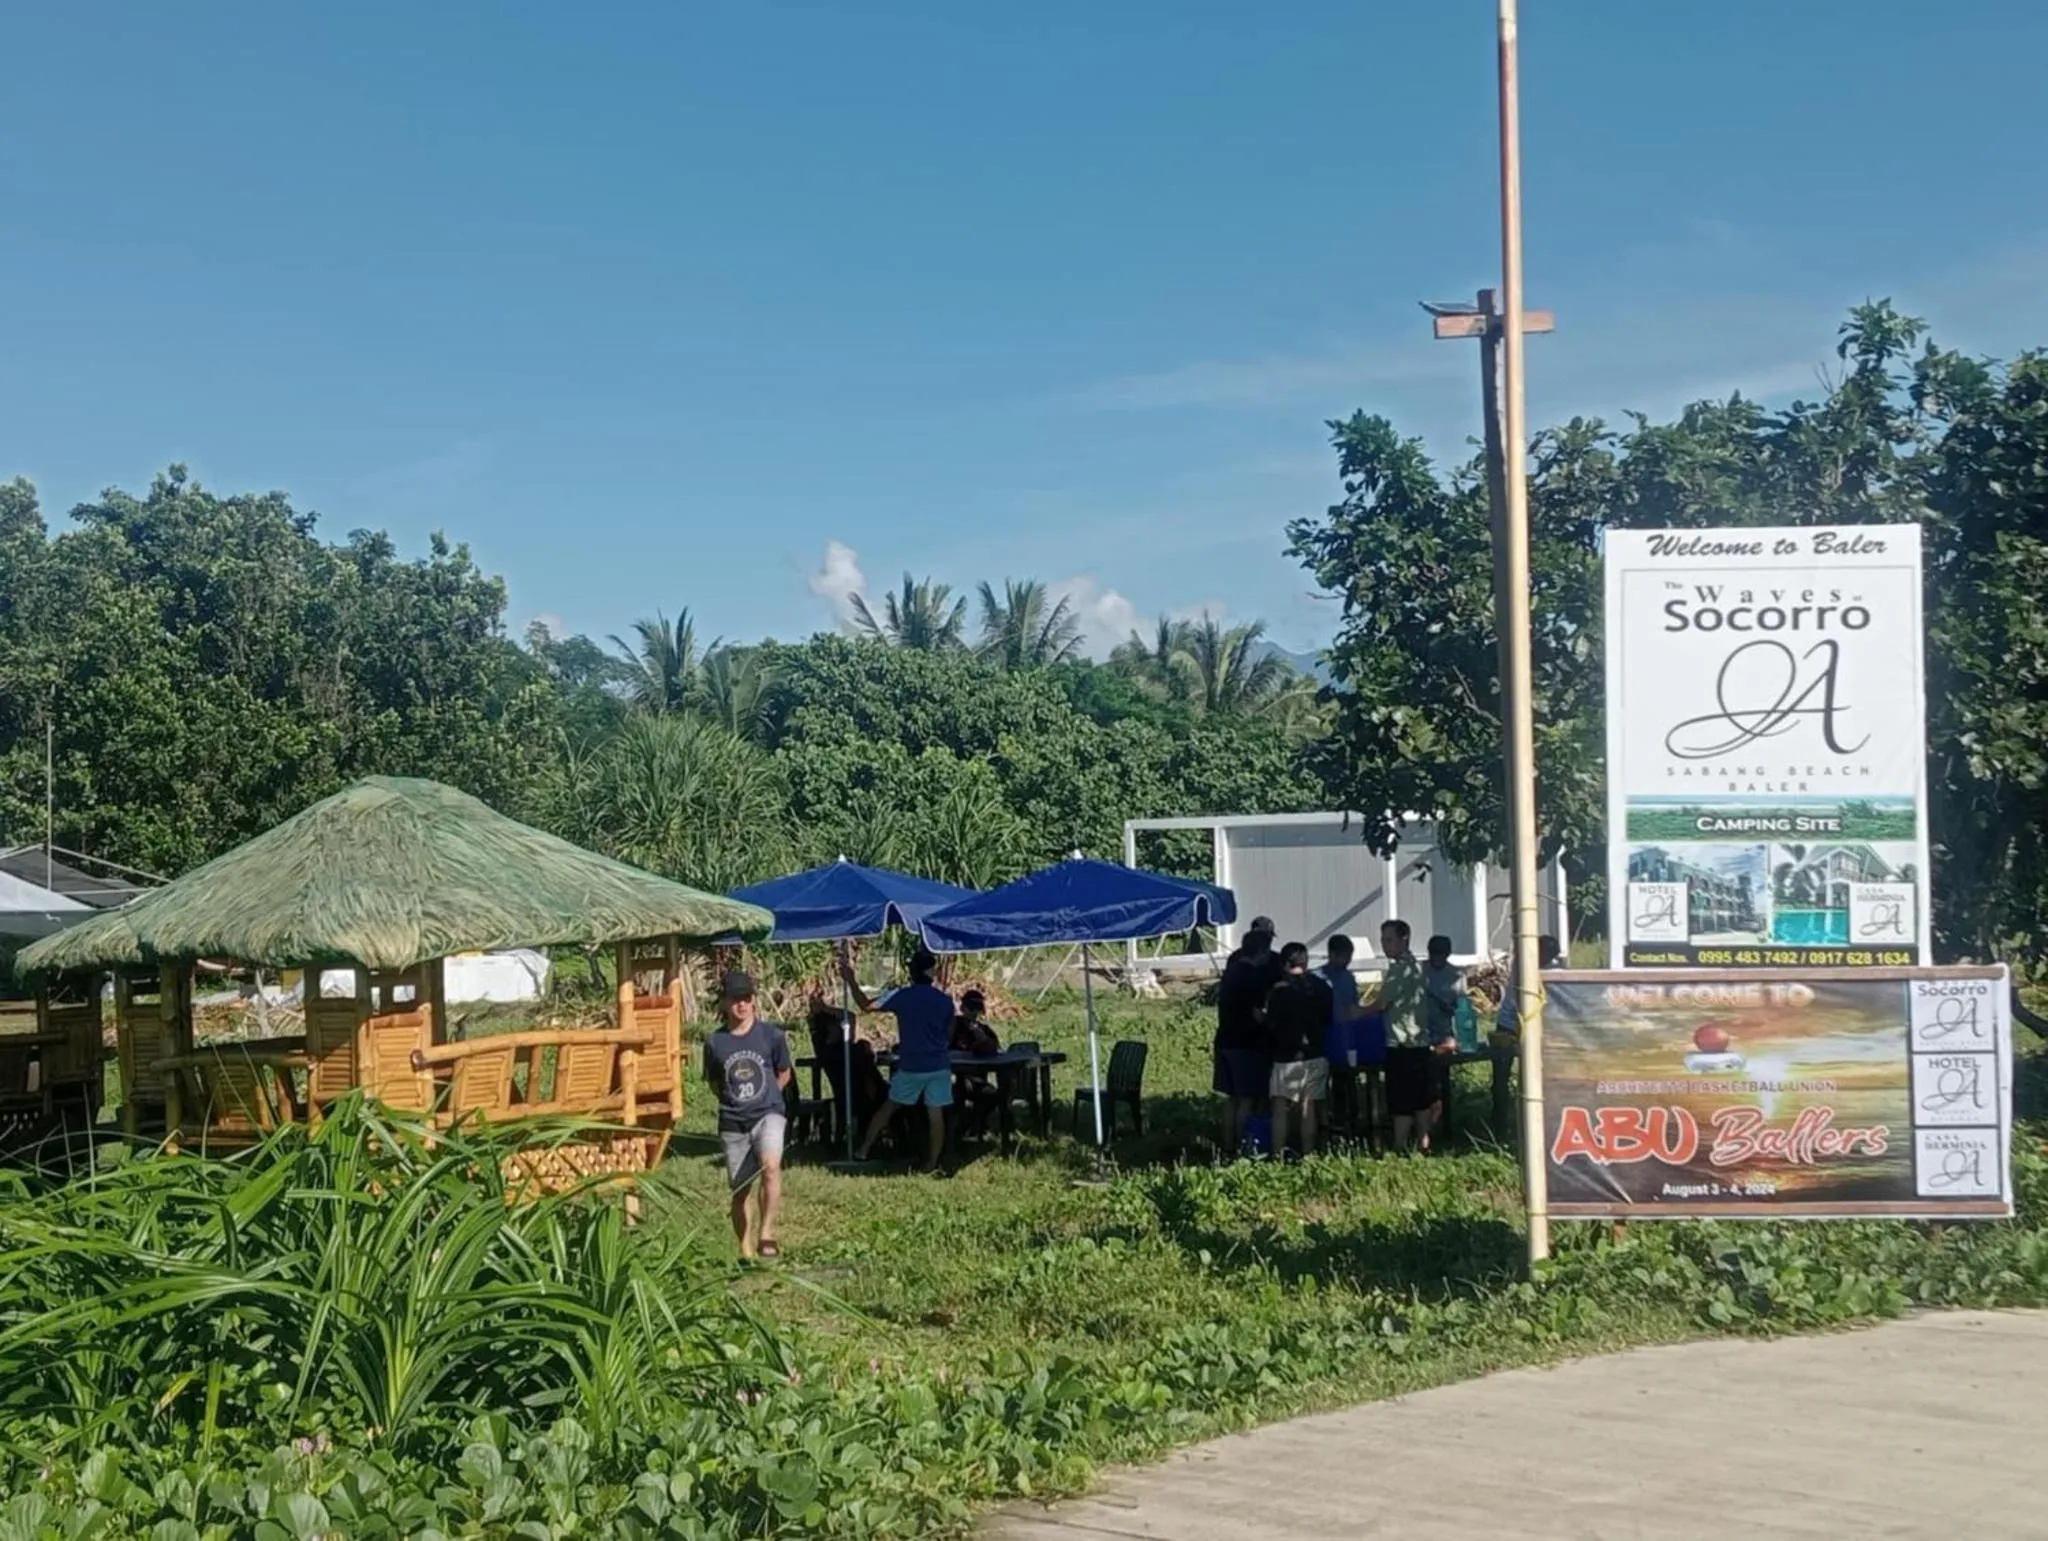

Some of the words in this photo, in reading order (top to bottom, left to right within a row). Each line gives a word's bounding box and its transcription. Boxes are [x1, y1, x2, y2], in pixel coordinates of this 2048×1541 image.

[1646, 533, 1764, 557] Welcome
[1772, 537, 1799, 555] to
[1812, 532, 1888, 555] Baler
[1694, 585, 1842, 604] Waves
[1664, 599, 1871, 632] Socorro
[1666, 766, 1765, 776] SABANG
[1788, 765, 1870, 776] BEACH
[1728, 782, 1808, 792] BALER
[1696, 817, 1791, 832] CAMPING
[1795, 816, 1841, 831] SITE
[1735, 950, 1761, 964] 483
[1763, 951, 1798, 964] 7492
[1809, 951, 1843, 964] 0917
[1605, 983, 1764, 1006] WELCOME
[1766, 983, 1816, 1006] TO
[1918, 984, 1988, 997] Socorro
[1928, 1057, 1981, 1069] HOTEL
[738, 1082, 755, 1099] 20
[1551, 1106, 1698, 1166] ABU
[1709, 1106, 1888, 1167] Ballers
[1662, 1183, 1709, 1198] August
